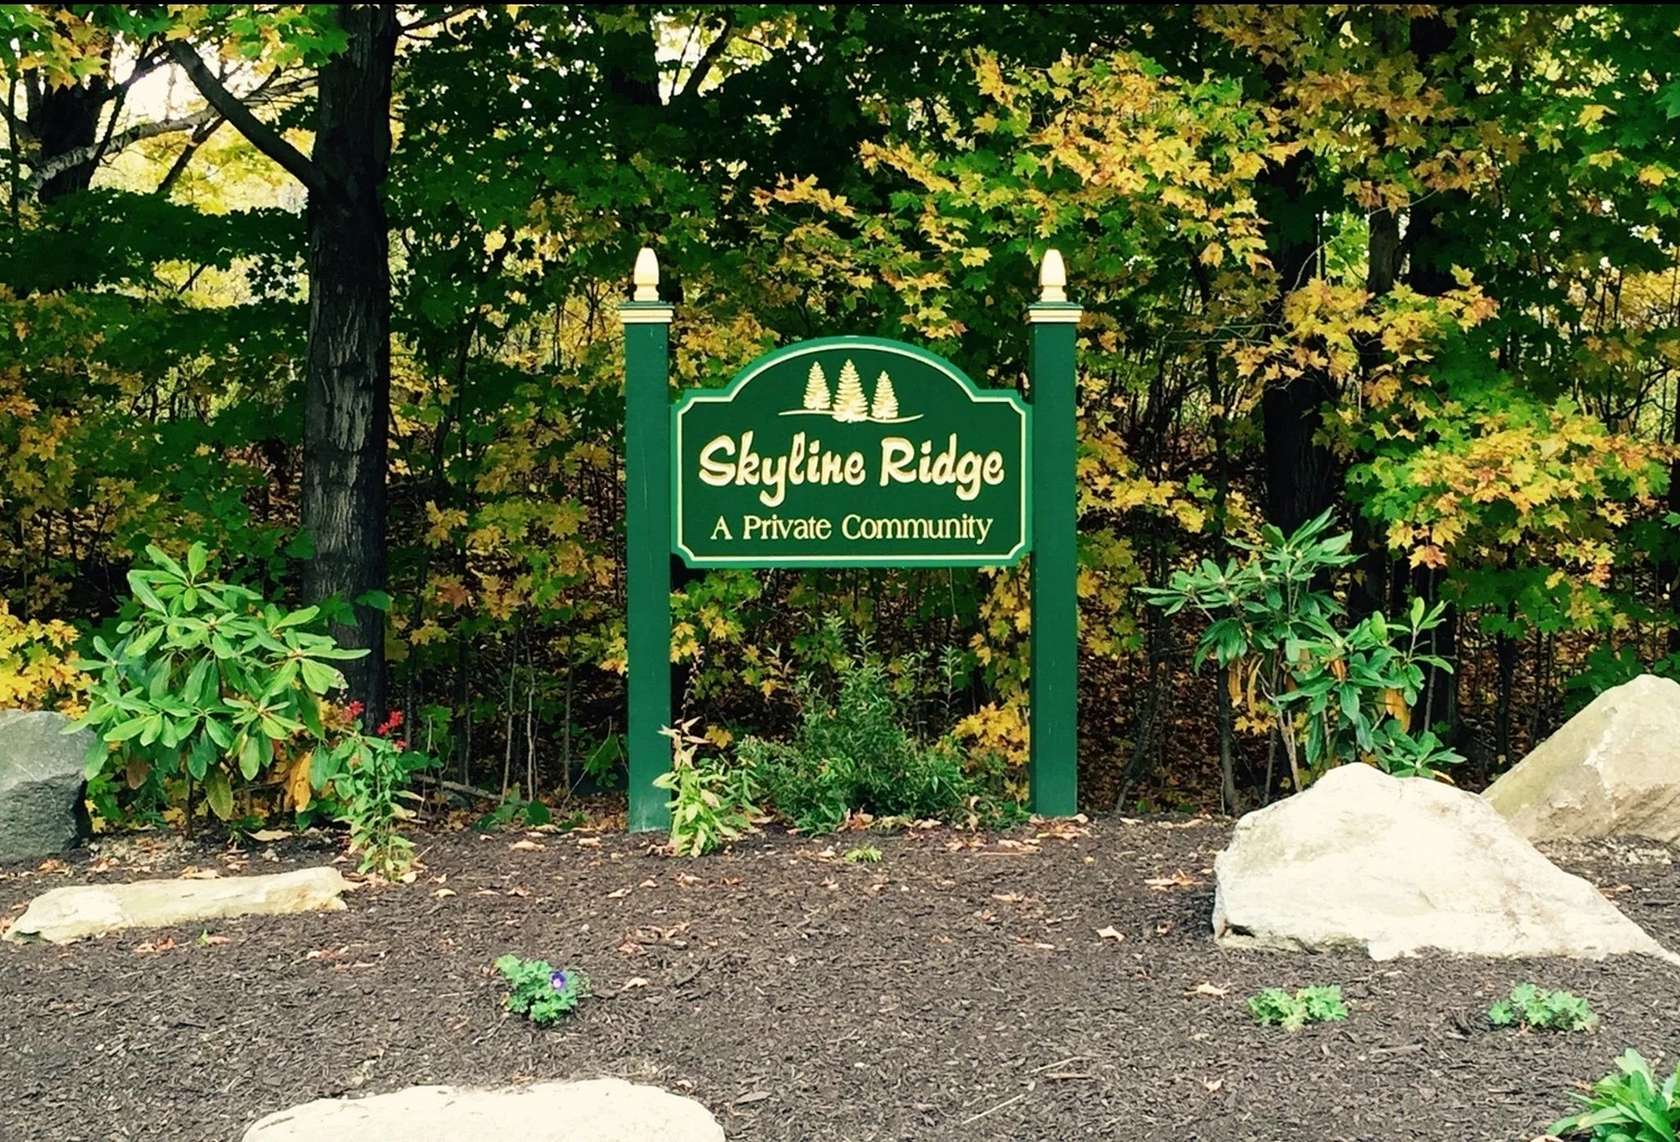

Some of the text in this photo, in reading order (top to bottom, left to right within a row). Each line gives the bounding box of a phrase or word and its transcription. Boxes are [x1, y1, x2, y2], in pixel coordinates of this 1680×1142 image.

[698, 430, 1005, 507] Skyline Ridge
[710, 513, 993, 545] A Private Community
